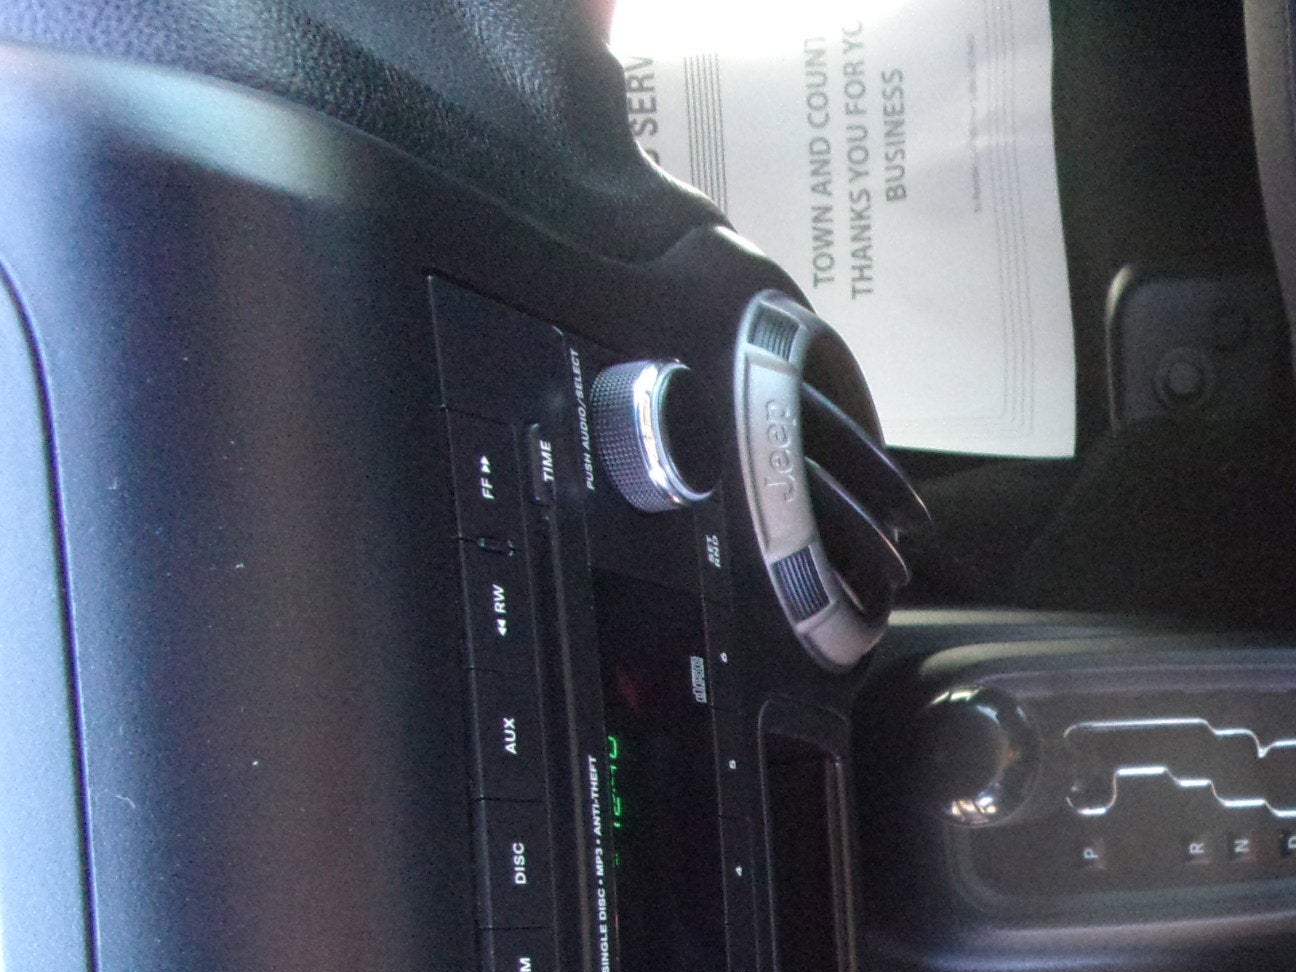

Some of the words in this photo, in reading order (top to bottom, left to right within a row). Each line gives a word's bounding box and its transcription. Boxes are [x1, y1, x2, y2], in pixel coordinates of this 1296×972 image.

[843, 61, 867, 116] FOR
[847, 124, 870, 183] YOU
[882, 68, 907, 201] BUSINESS
[809, 137, 833, 197] AND
[812, 204, 835, 288] TOWN
[850, 189, 873, 299] THANKS
[570, 349, 591, 450] AUDIO/SELECT
[539, 440, 554, 482] TIME
[583, 453, 595, 491] PUSH
[765, 399, 797, 503] Jeep
[480, 478, 494, 499] FF
[706, 535, 714, 563] SET
[493, 584, 507, 613] RW
[503, 718, 517, 754] AUX
[589, 755, 602, 836] ANTI-THEFT
[512, 842, 527, 885] DISC
[595, 848, 605, 877] MP3
[1084, 848, 1098, 859] P
[1190, 842, 1205, 854] R
[1235, 839, 1249, 852] N
[597, 887, 607, 920] DISC
